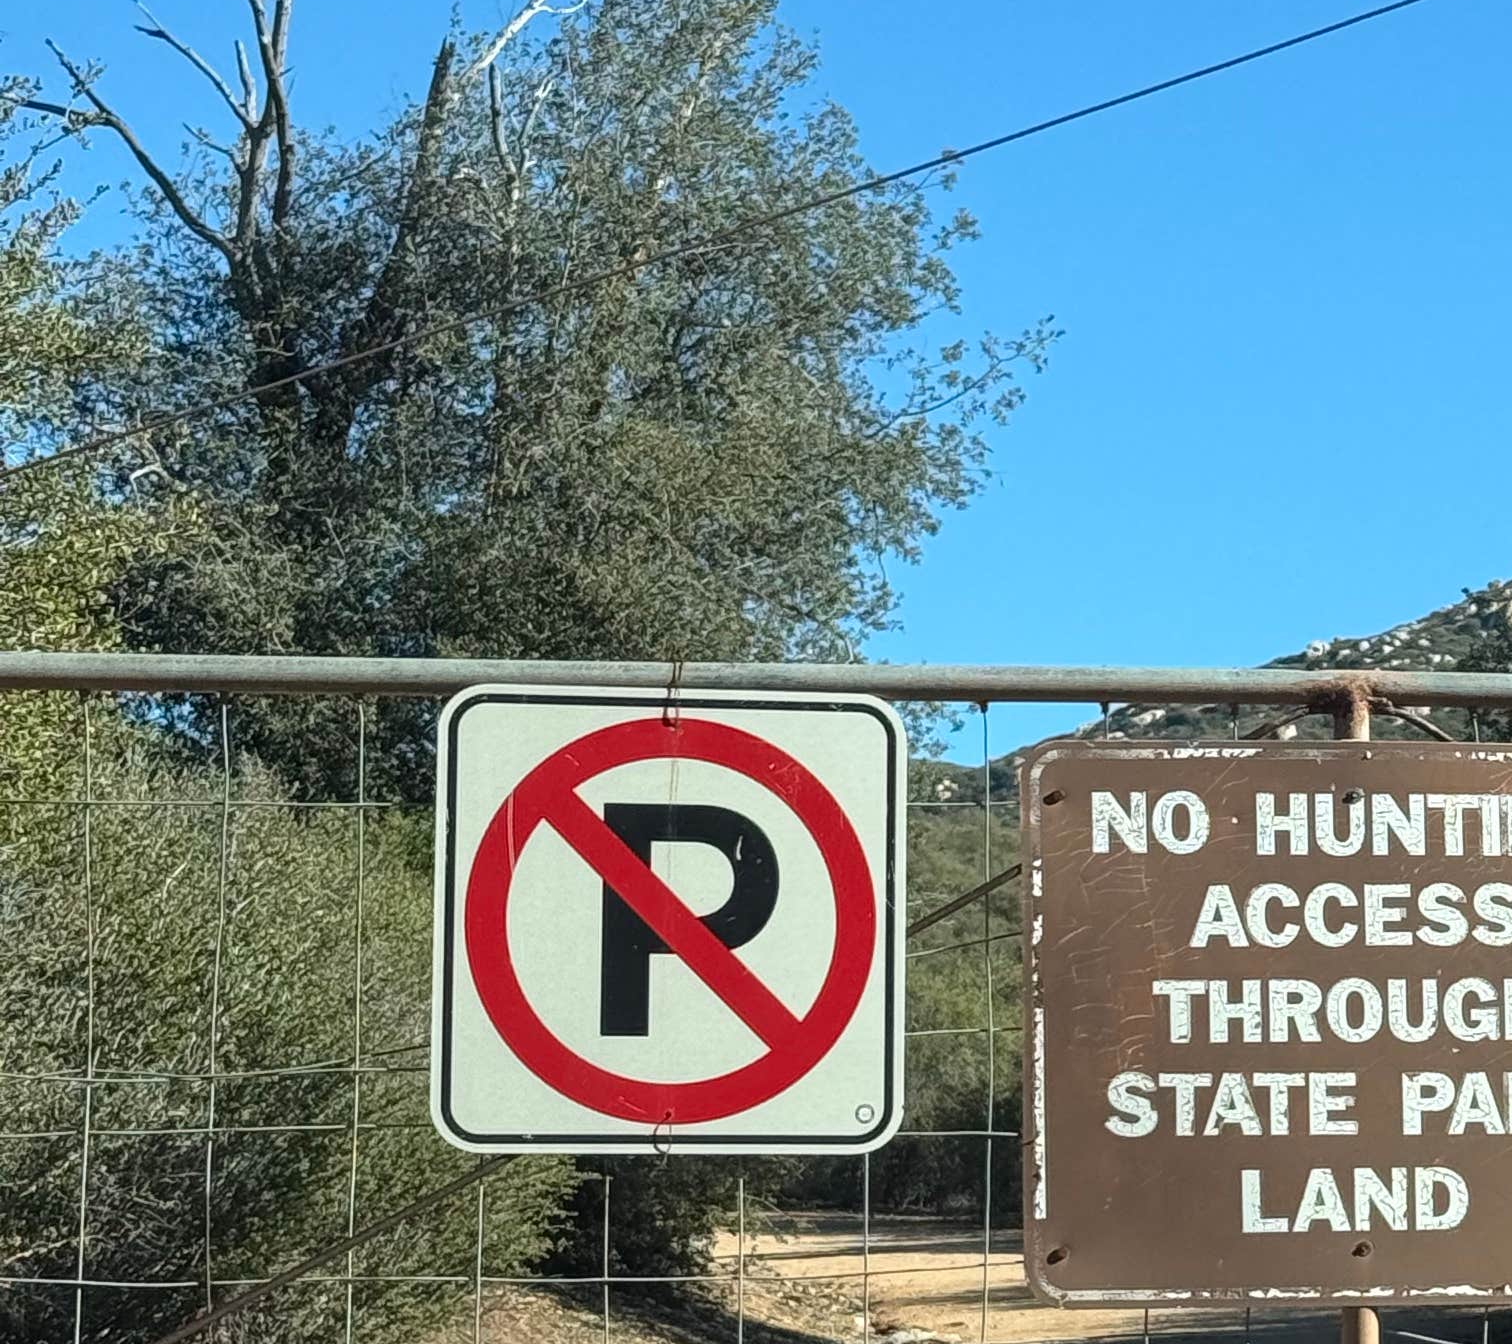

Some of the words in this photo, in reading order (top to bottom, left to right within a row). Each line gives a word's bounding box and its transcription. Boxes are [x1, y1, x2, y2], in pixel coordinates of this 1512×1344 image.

[1091, 791, 1210, 855] NO
[1105, 1071, 1358, 1138] STATE
[1241, 1166, 1470, 1233] LAND
